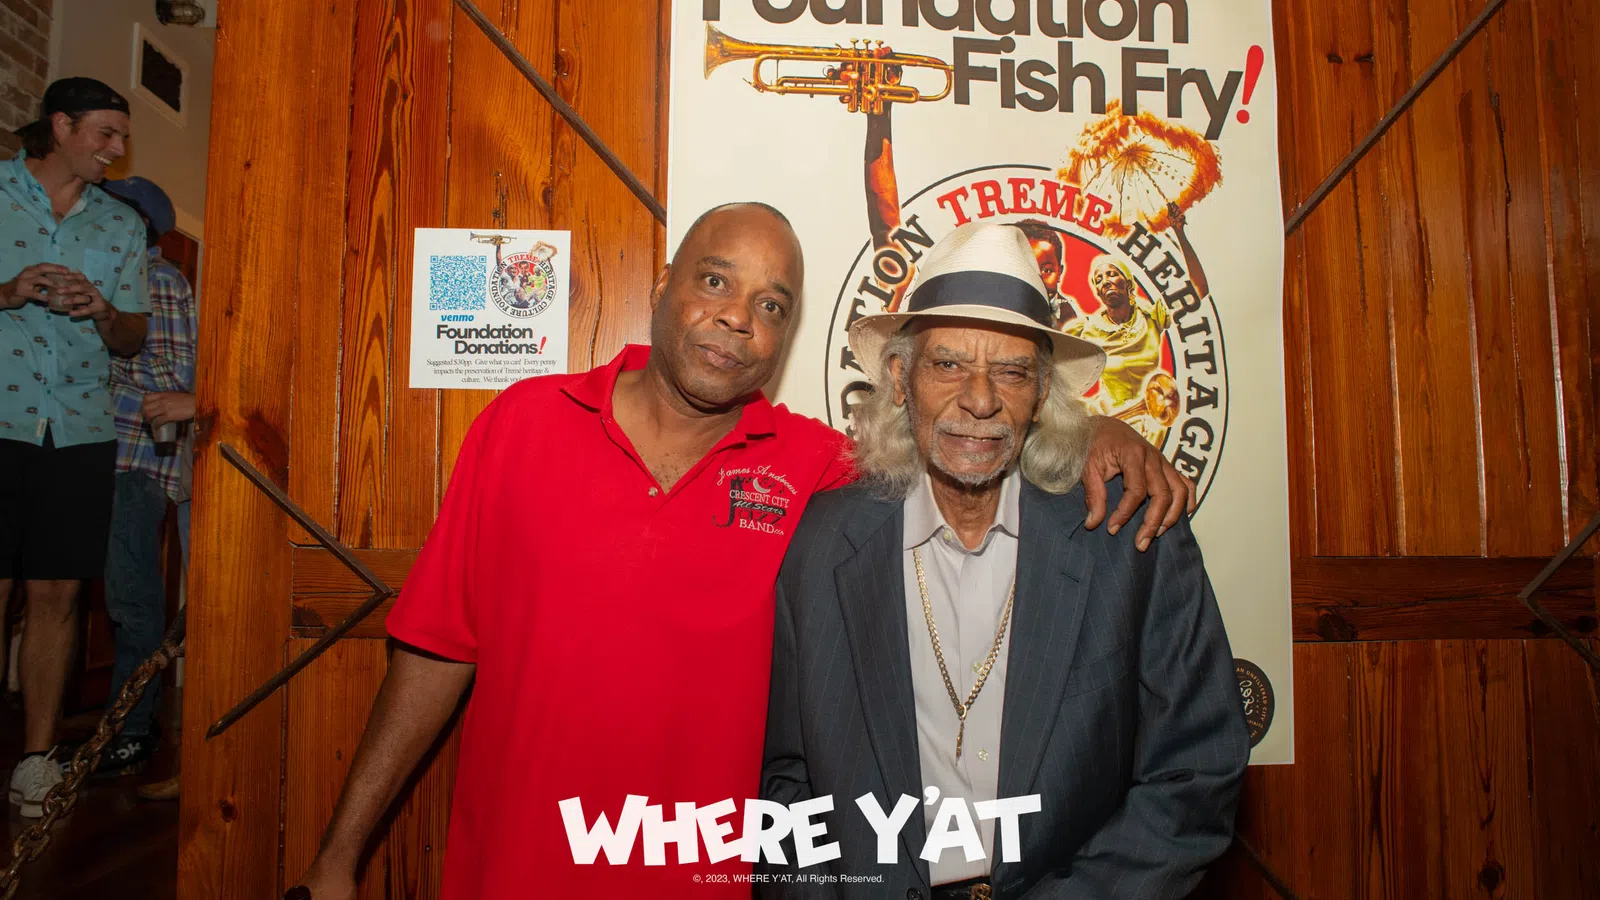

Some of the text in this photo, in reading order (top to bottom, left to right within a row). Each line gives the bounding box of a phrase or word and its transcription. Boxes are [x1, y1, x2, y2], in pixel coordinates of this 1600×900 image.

[953, 36, 1264, 141] Fish Fry!
[491, 254, 555, 317] TREME HERITAGE CULTURE FOUNDATION
[441, 314, 474, 322] venmo
[436, 323, 533, 339] Foundation
[937, 177, 1219, 486] TREME HERITAGE
[454, 336, 547, 355] Donations!
[426, 358, 453, 367] Suggested
[475, 358, 489, 366] Give
[488, 358, 503, 366] what
[524, 358, 539, 367] Every
[540, 359, 557, 367] penny
[433, 367, 454, 376] impacts
[455, 367, 464, 375] the
[464, 367, 497, 376] preservation
[522, 367, 544, 376] heritage
[717, 465, 798, 495] James Andrews
[729, 489, 790, 509] CRESCENT CITY
[733, 500, 784, 515] All Stars
[739, 518, 775, 534] BAND
